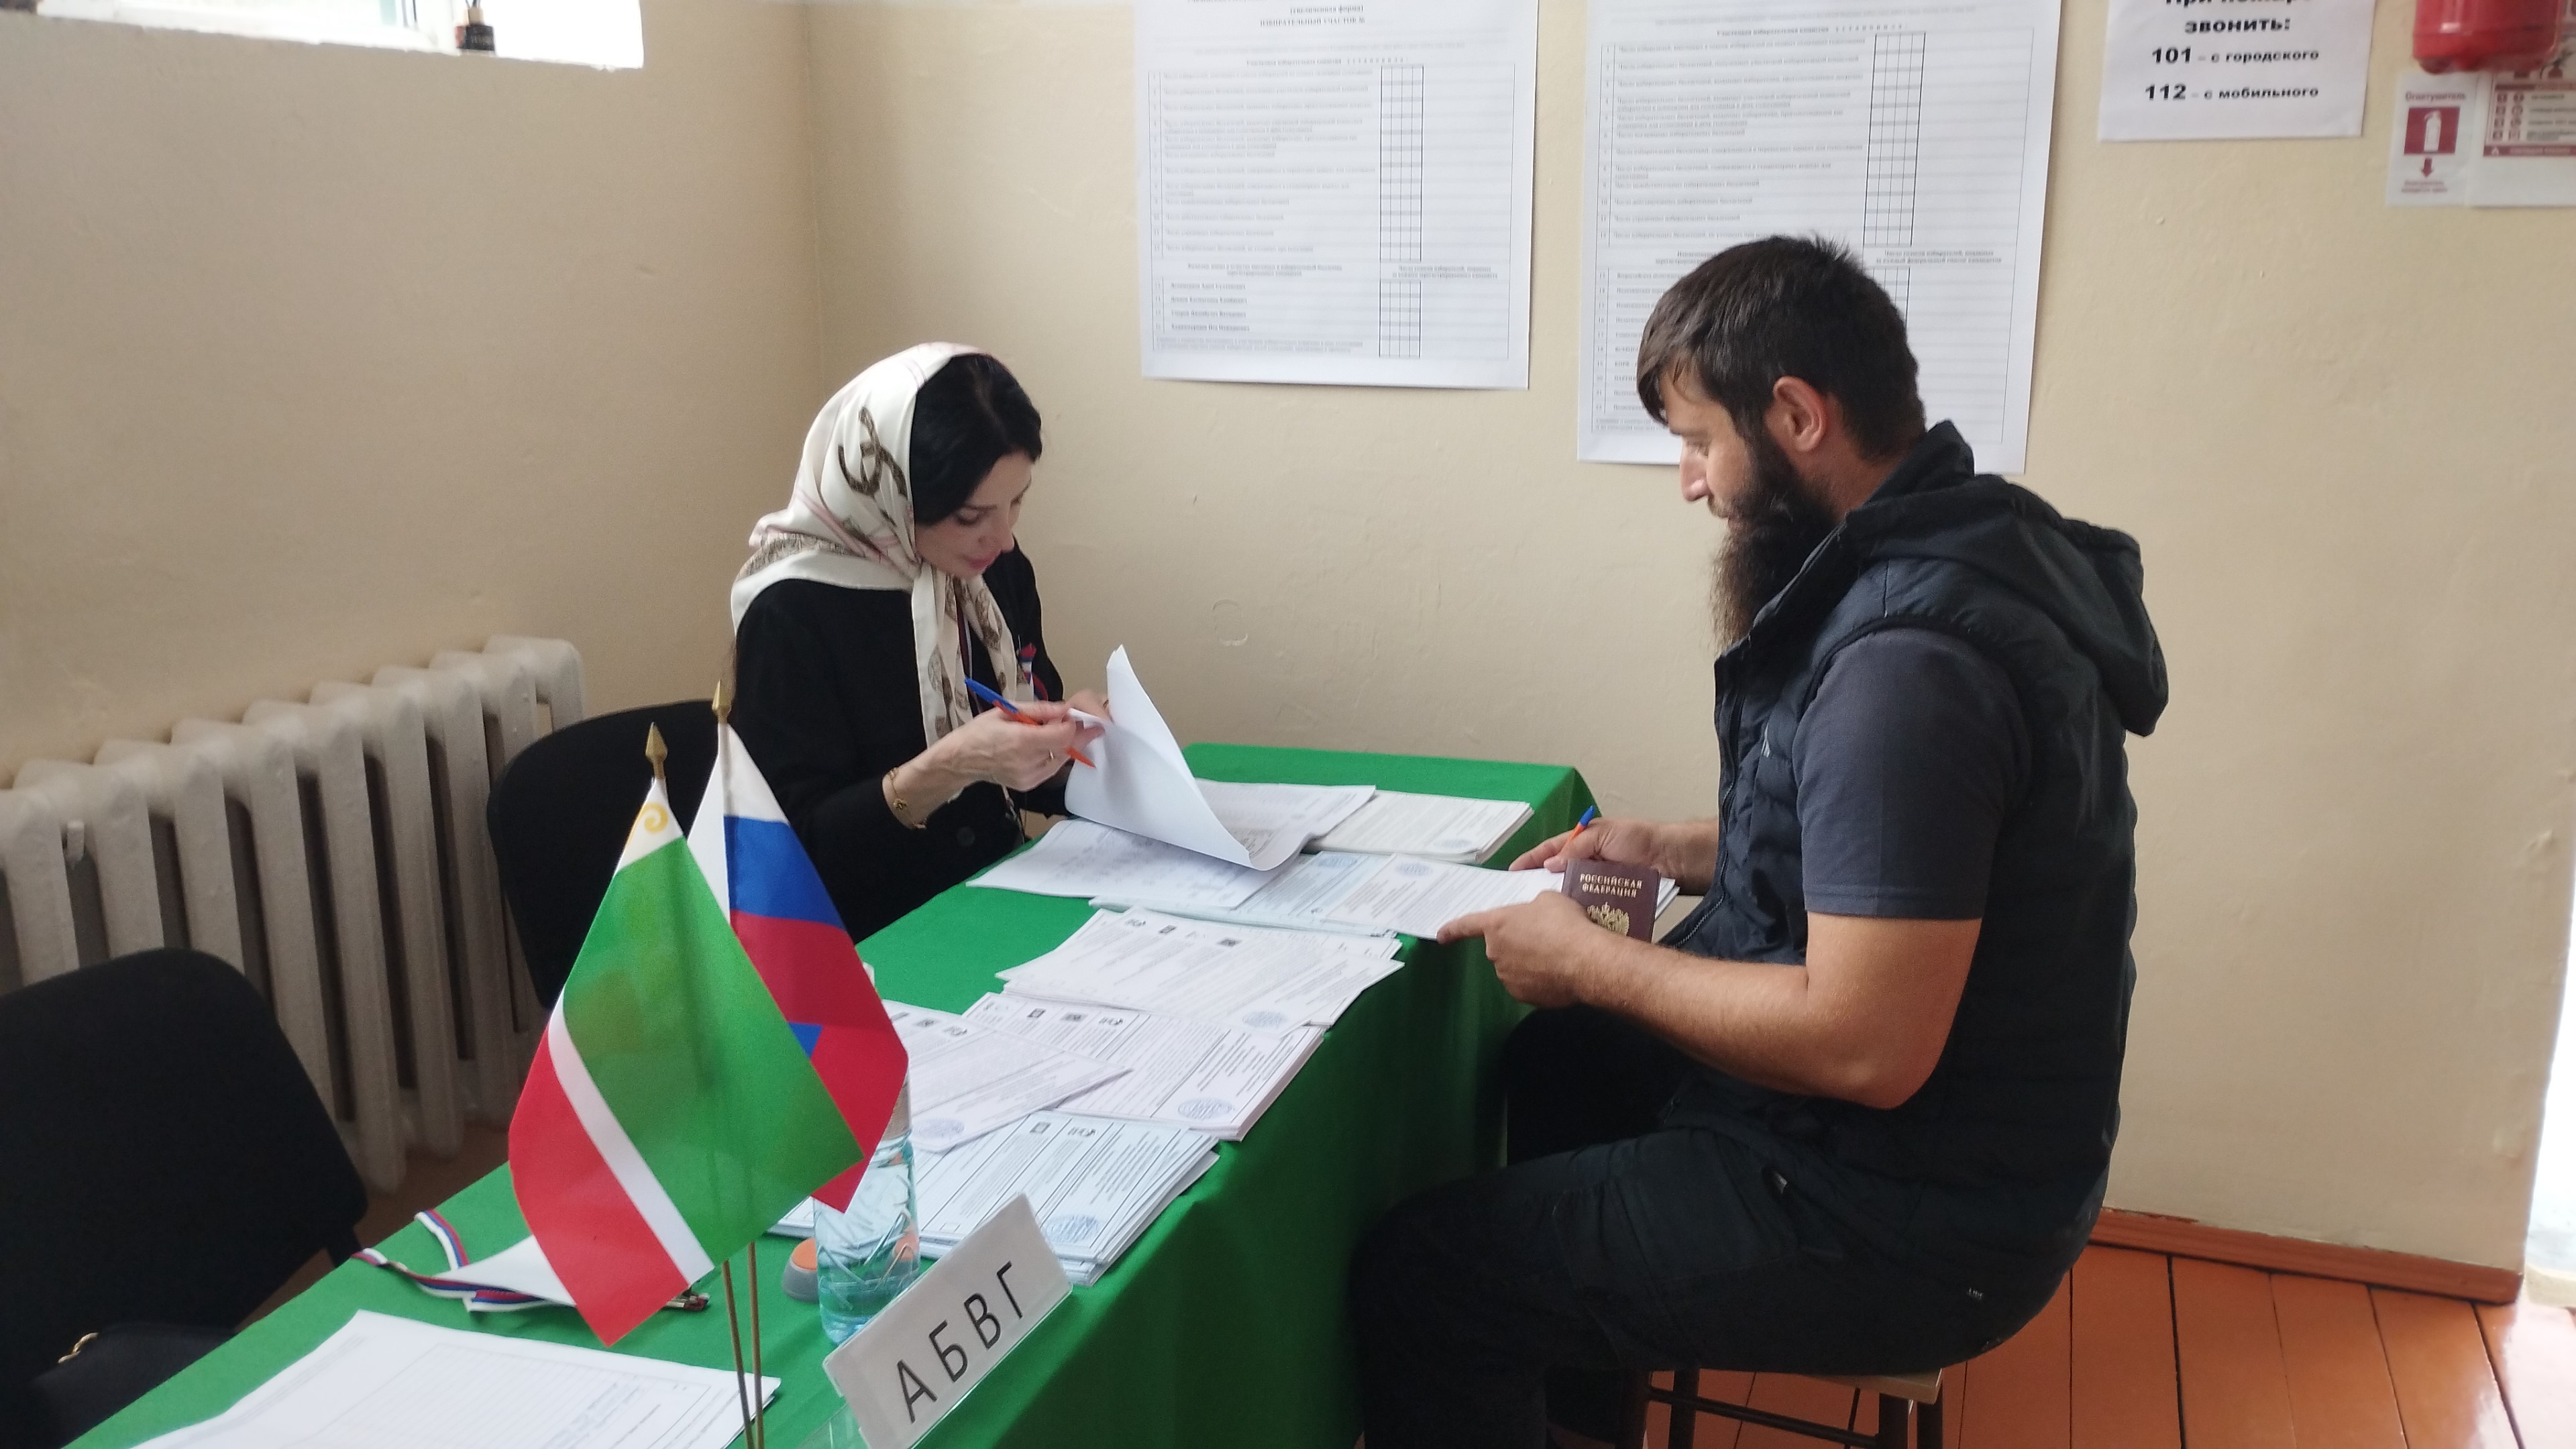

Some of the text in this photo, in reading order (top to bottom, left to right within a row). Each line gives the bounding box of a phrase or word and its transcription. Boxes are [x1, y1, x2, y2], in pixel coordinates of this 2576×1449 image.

[2184, 17, 2291, 34] звонить:
[2151, 46, 2192, 64] 101
[2225, 50, 2320, 64] городского
[2145, 83, 2186, 100] 112
[2218, 87, 2319, 99] мобильного
[1580, 873, 1642, 889] РОССИЙСКАЯ
[1582, 883, 1637, 898] ФЕДЕРАЦИЯ
